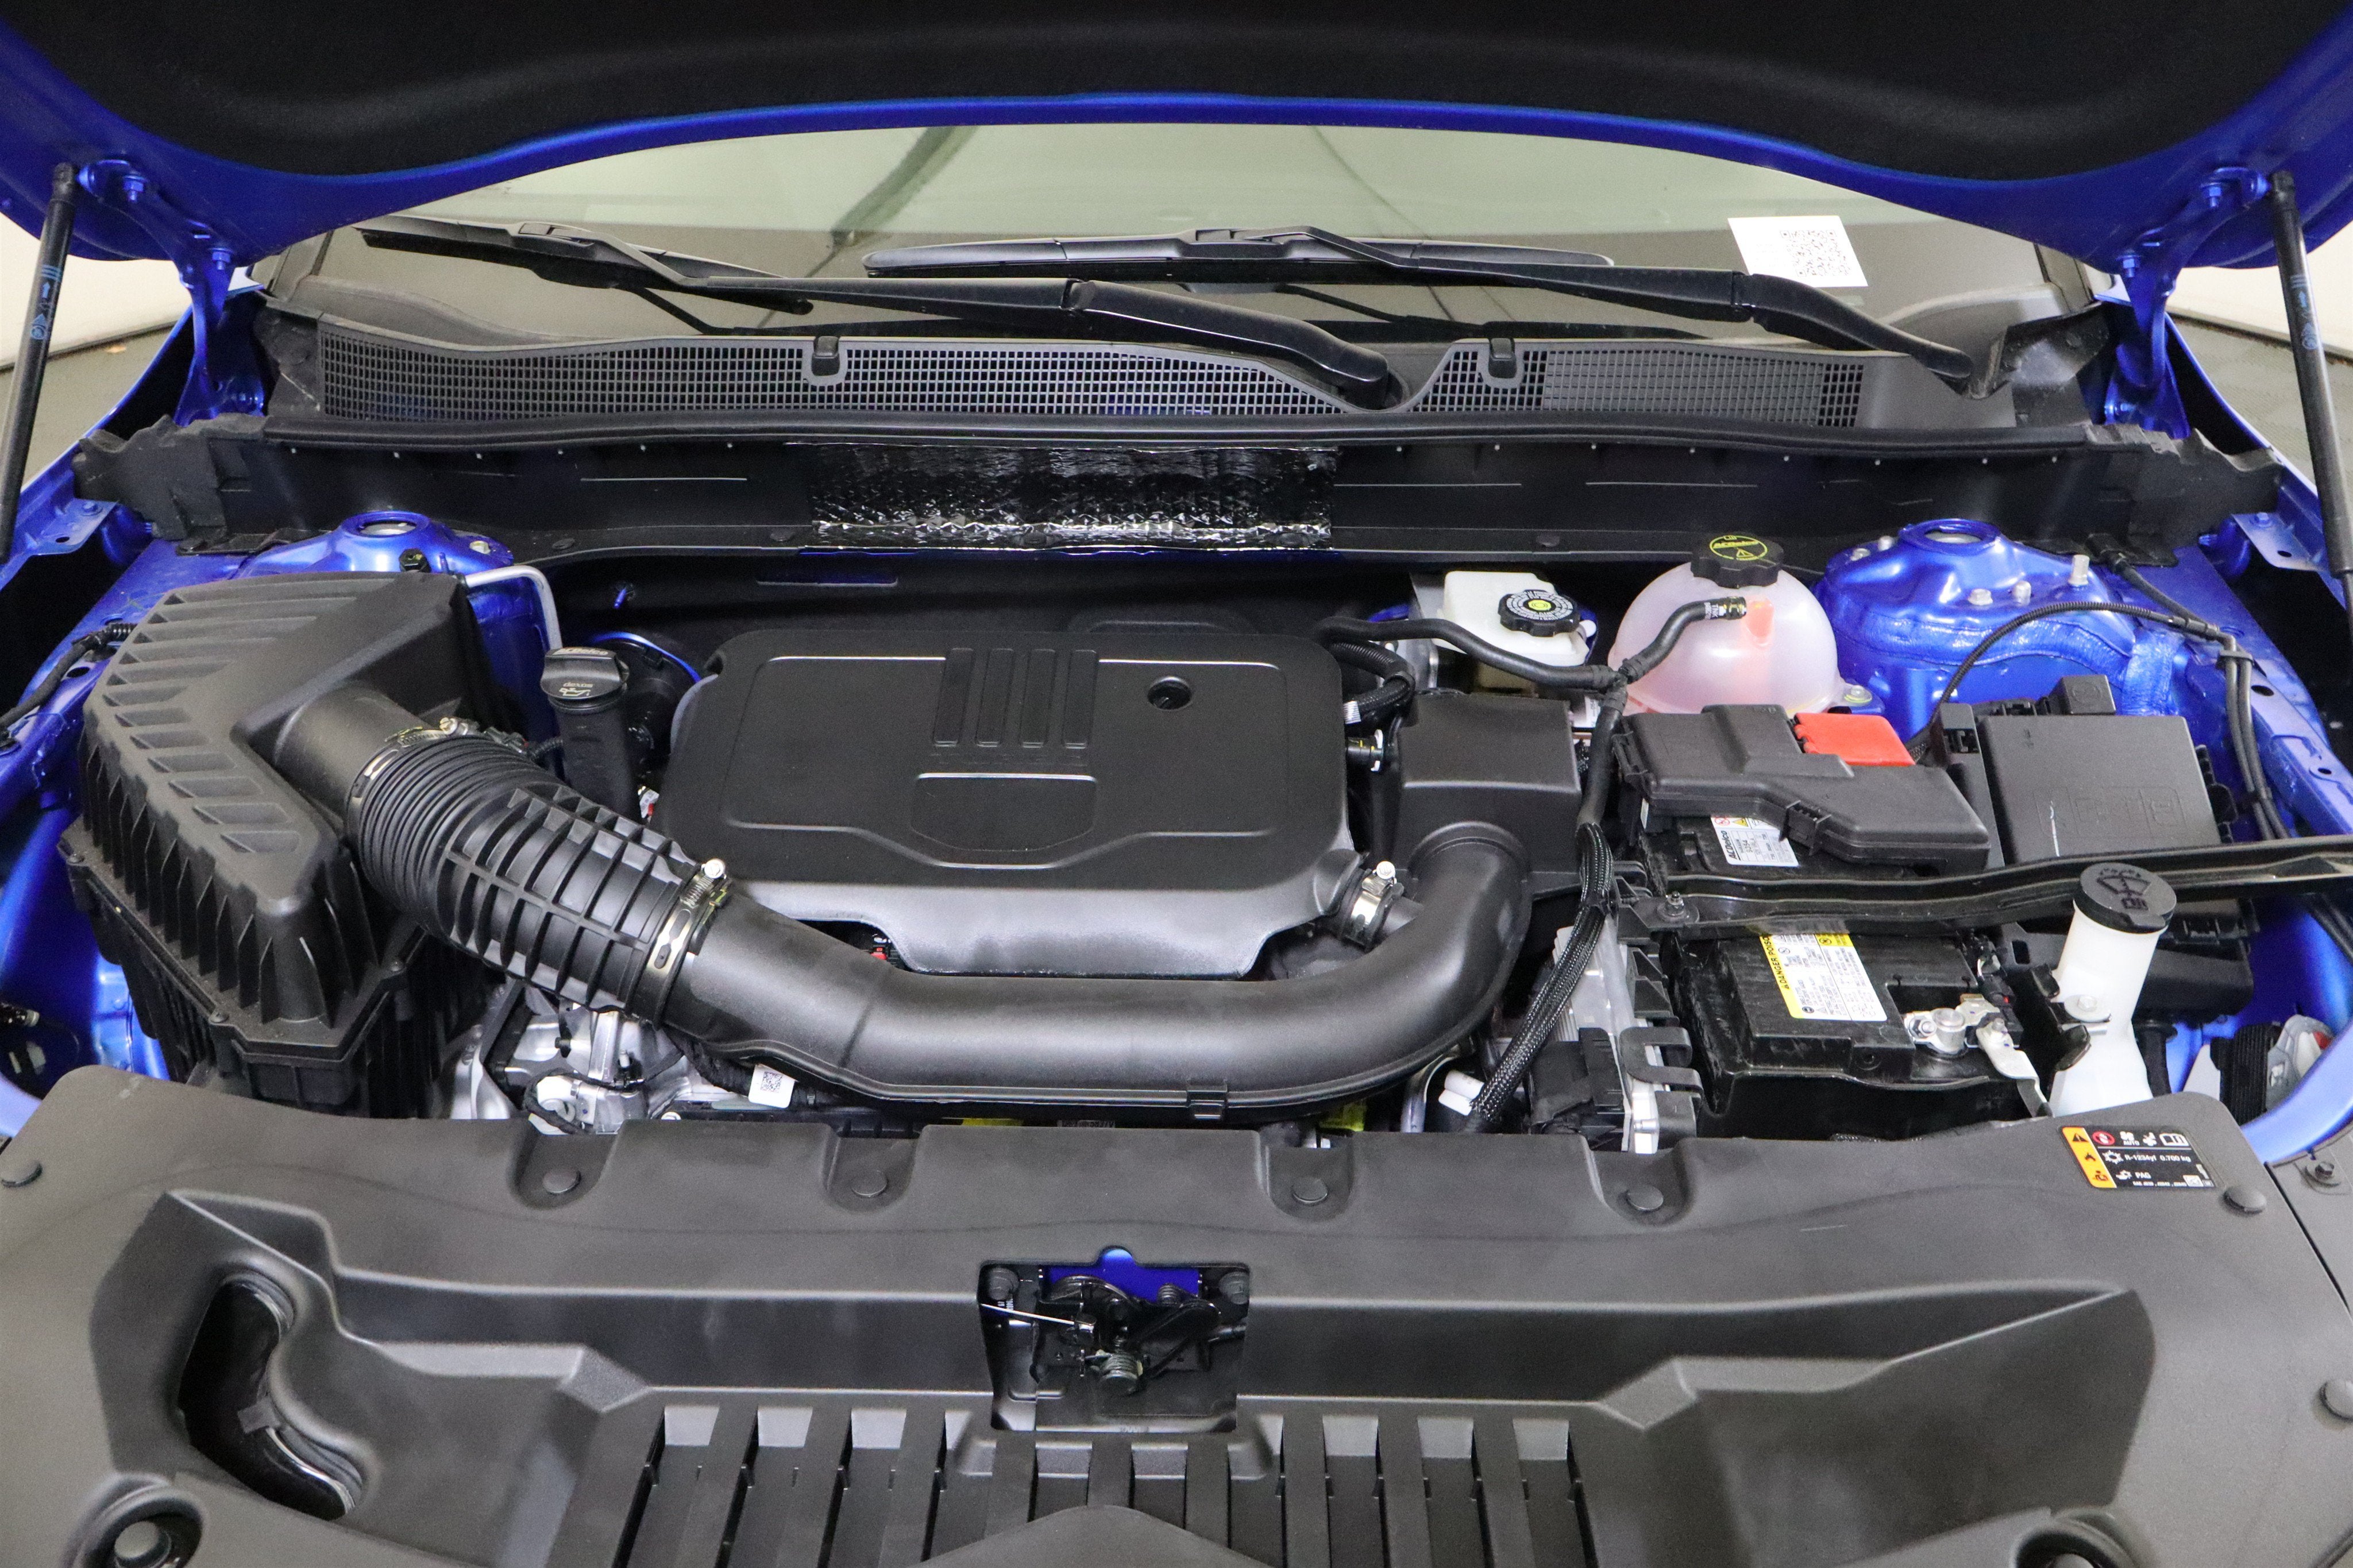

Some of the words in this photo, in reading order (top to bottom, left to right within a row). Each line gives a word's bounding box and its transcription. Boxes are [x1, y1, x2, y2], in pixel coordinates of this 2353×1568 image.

[552, 647, 608, 655] ACDelco
[1721, 830, 1738, 860] ACDelco
[1770, 957, 1787, 986] DANGER
[2124, 1154, 2157, 1162] R-1234yf
[2180, 1154, 2192, 1163] kg
